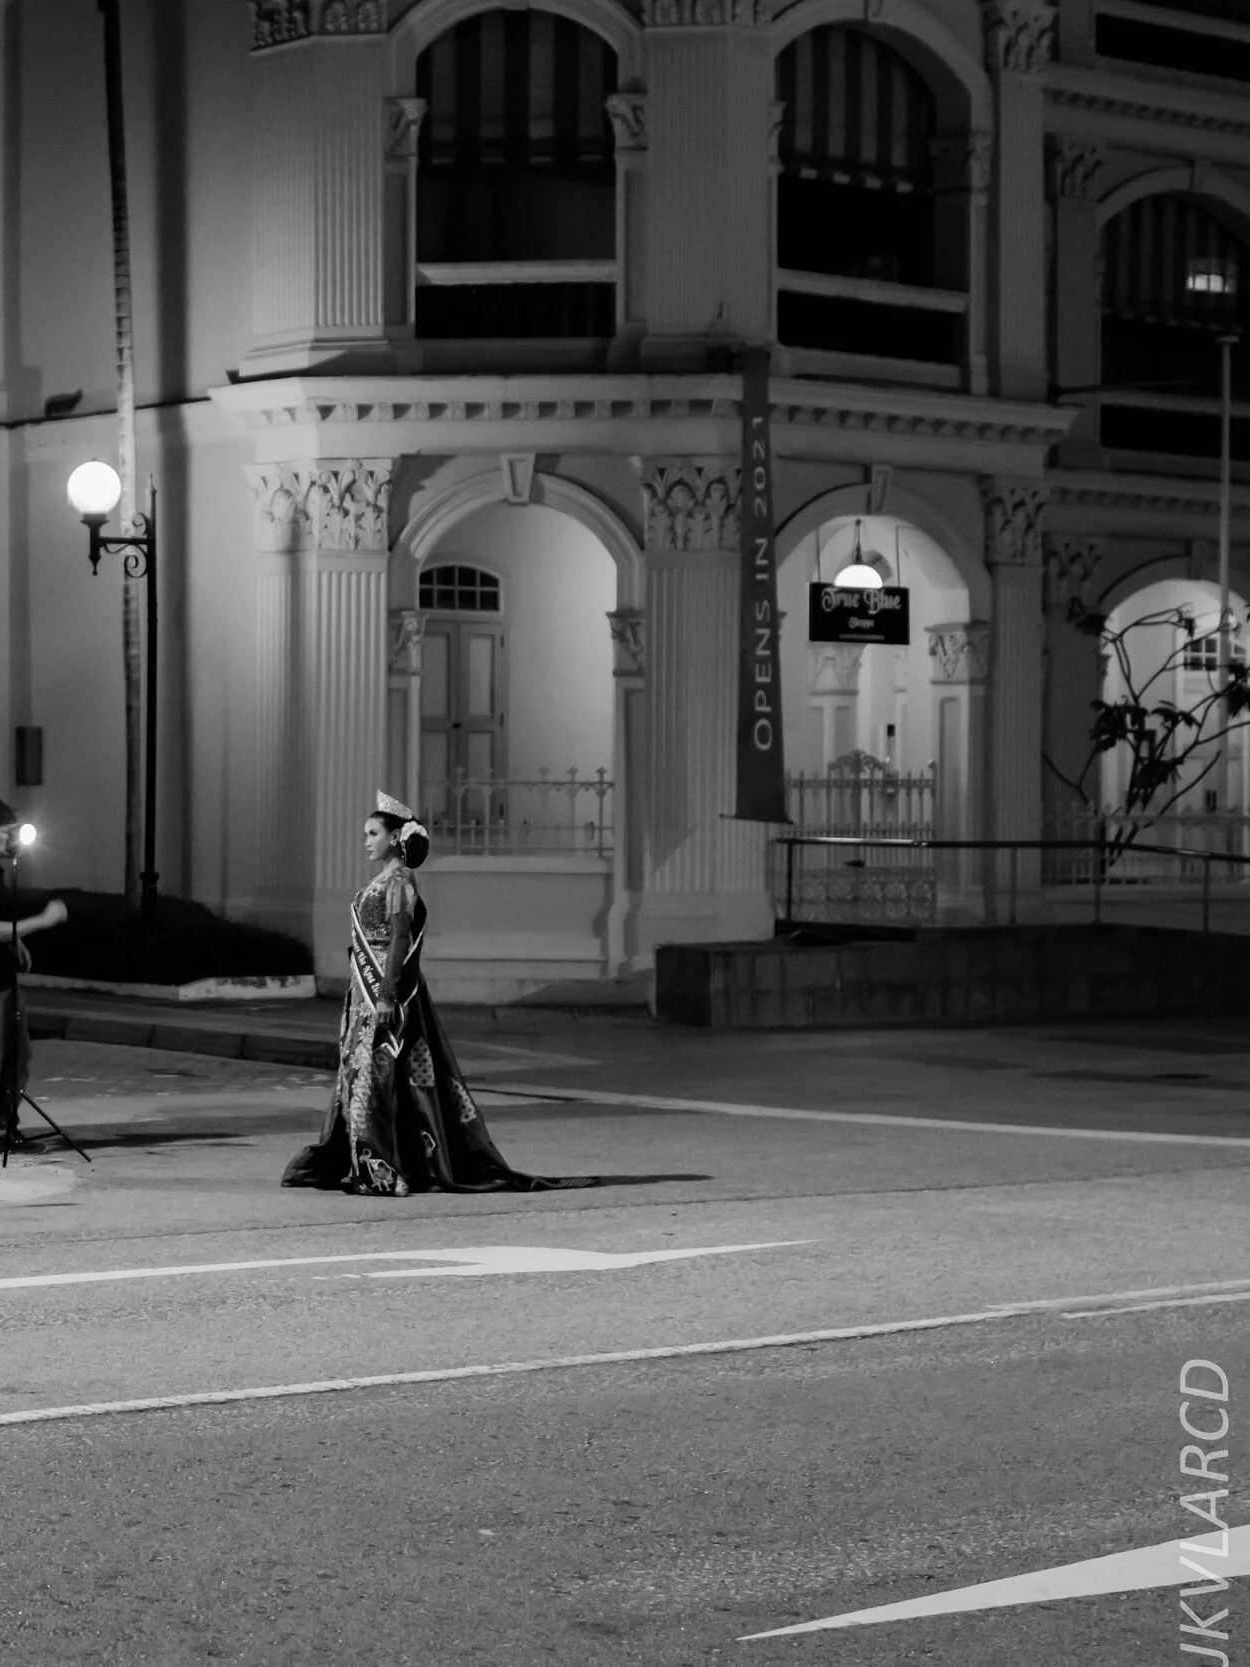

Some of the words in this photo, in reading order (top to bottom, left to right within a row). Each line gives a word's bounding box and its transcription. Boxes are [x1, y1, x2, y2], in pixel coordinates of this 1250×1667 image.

[753, 416, 767, 517] 2021
[755, 537, 769, 580] IN
[821, 586, 860, 612] True
[863, 588, 902, 615] Blue
[754, 600, 772, 751] OPENS
